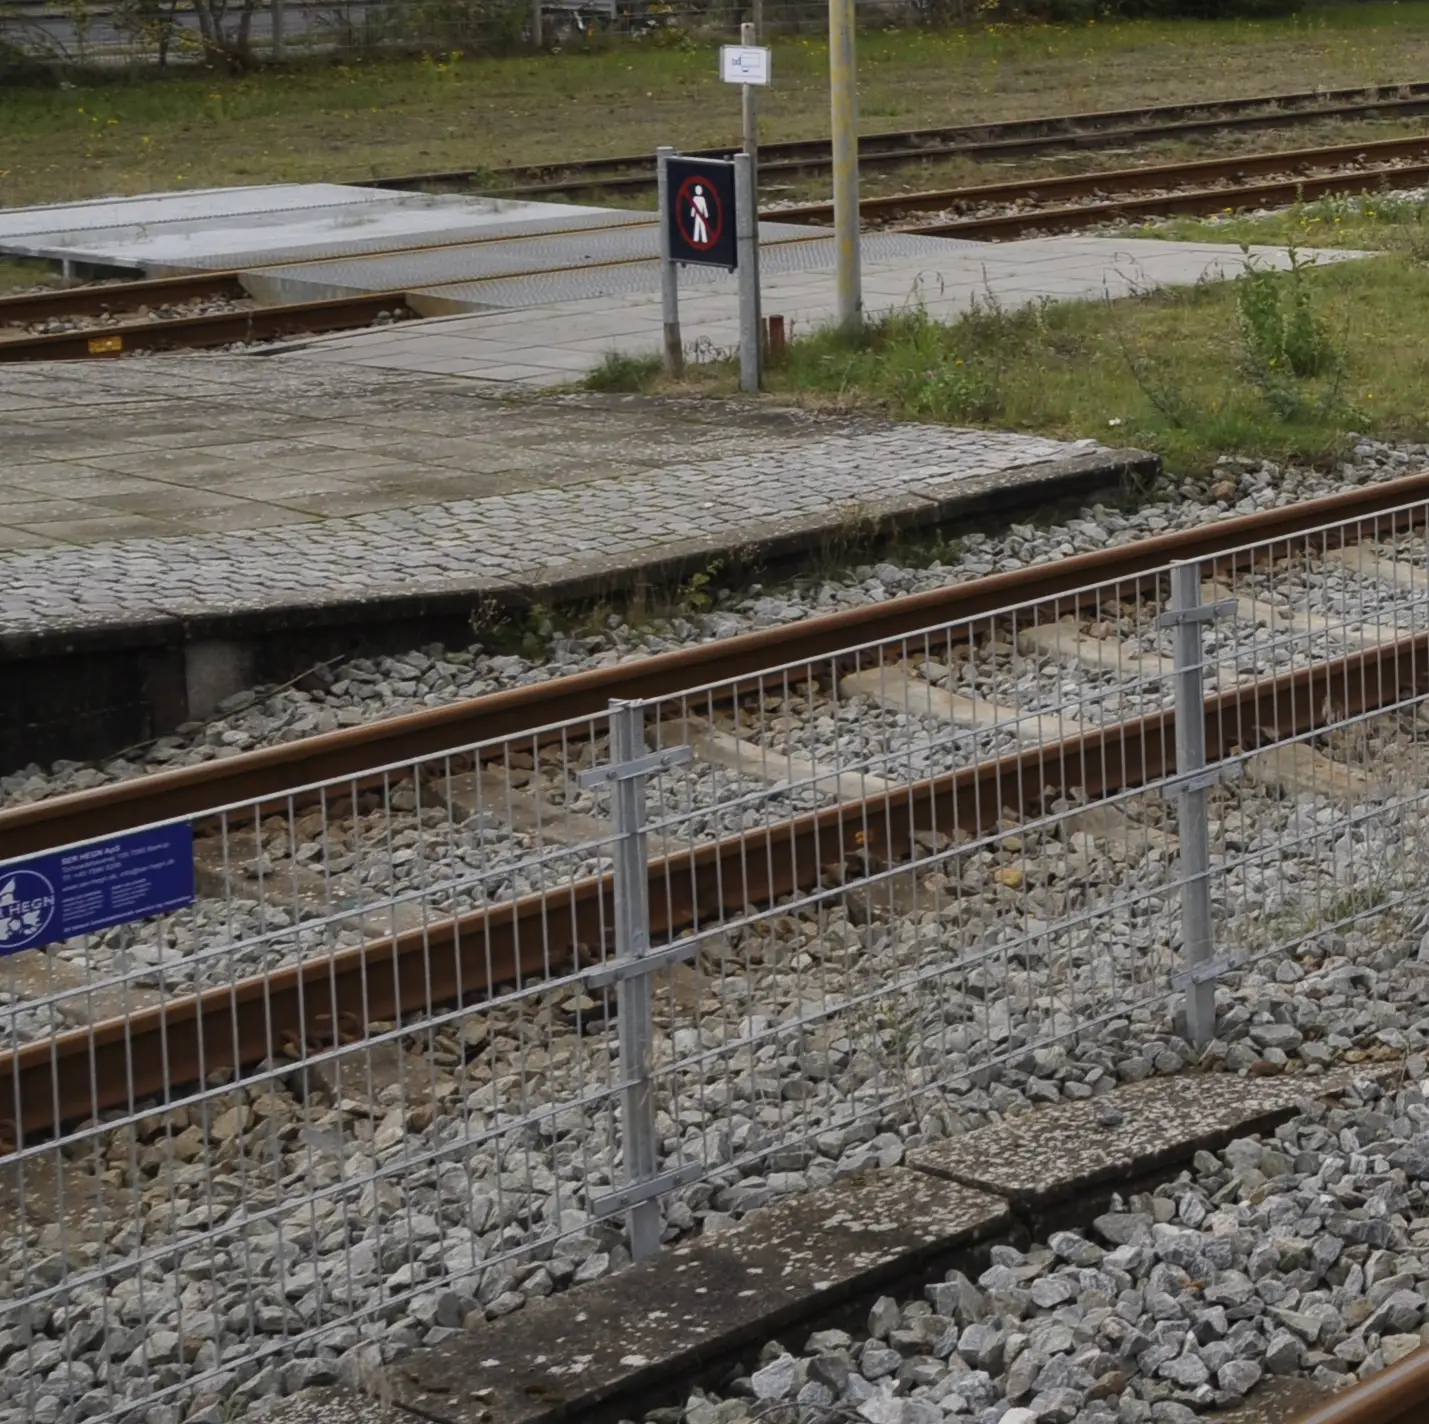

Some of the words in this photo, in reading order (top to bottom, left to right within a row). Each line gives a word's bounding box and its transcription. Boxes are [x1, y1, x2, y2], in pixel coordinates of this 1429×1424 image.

[80, 849, 103, 861] HEGN
[104, 844, 120, 855] ApS
[9, 895, 55, 916] HEGN
